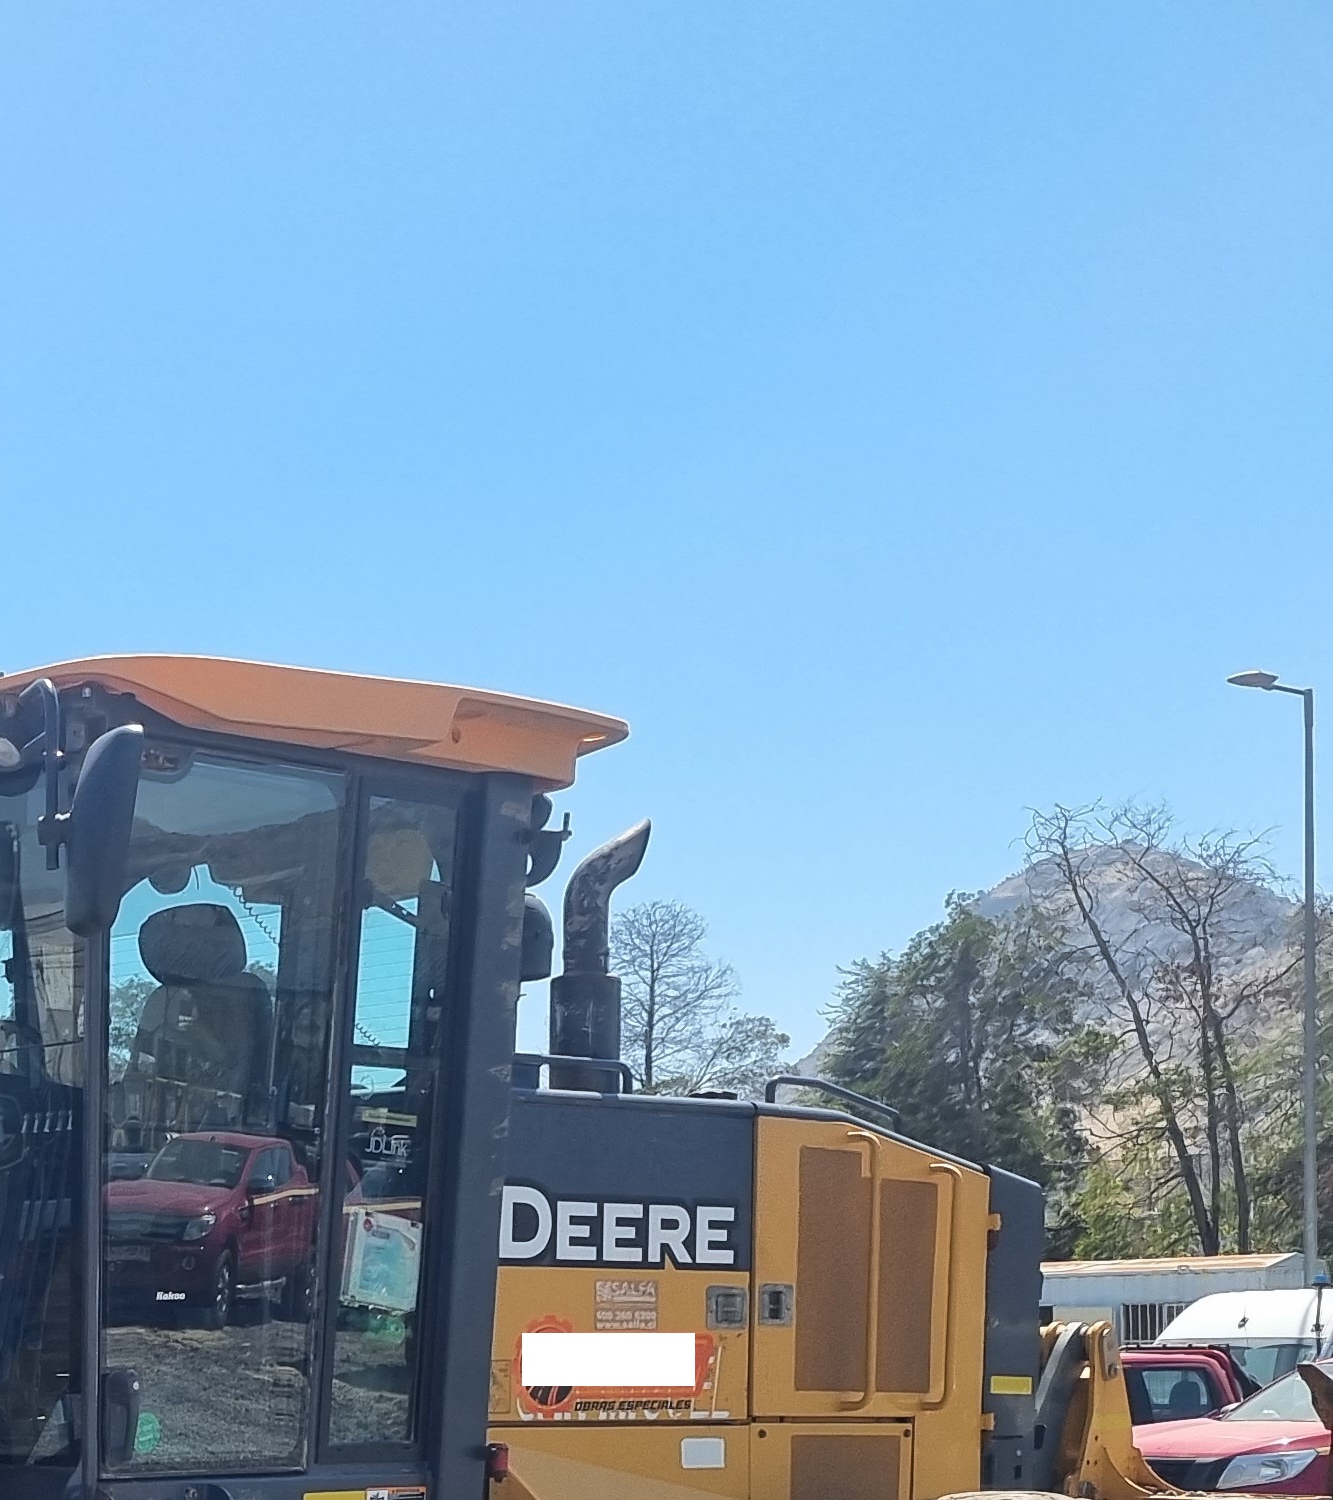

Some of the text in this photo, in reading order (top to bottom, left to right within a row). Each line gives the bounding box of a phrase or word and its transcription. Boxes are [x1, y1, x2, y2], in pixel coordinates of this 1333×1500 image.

[499, 1185, 735, 1264] DEERE
[575, 1400, 615, 1412] OBRAS
[617, 1399, 692, 1411] ESPECIALES
